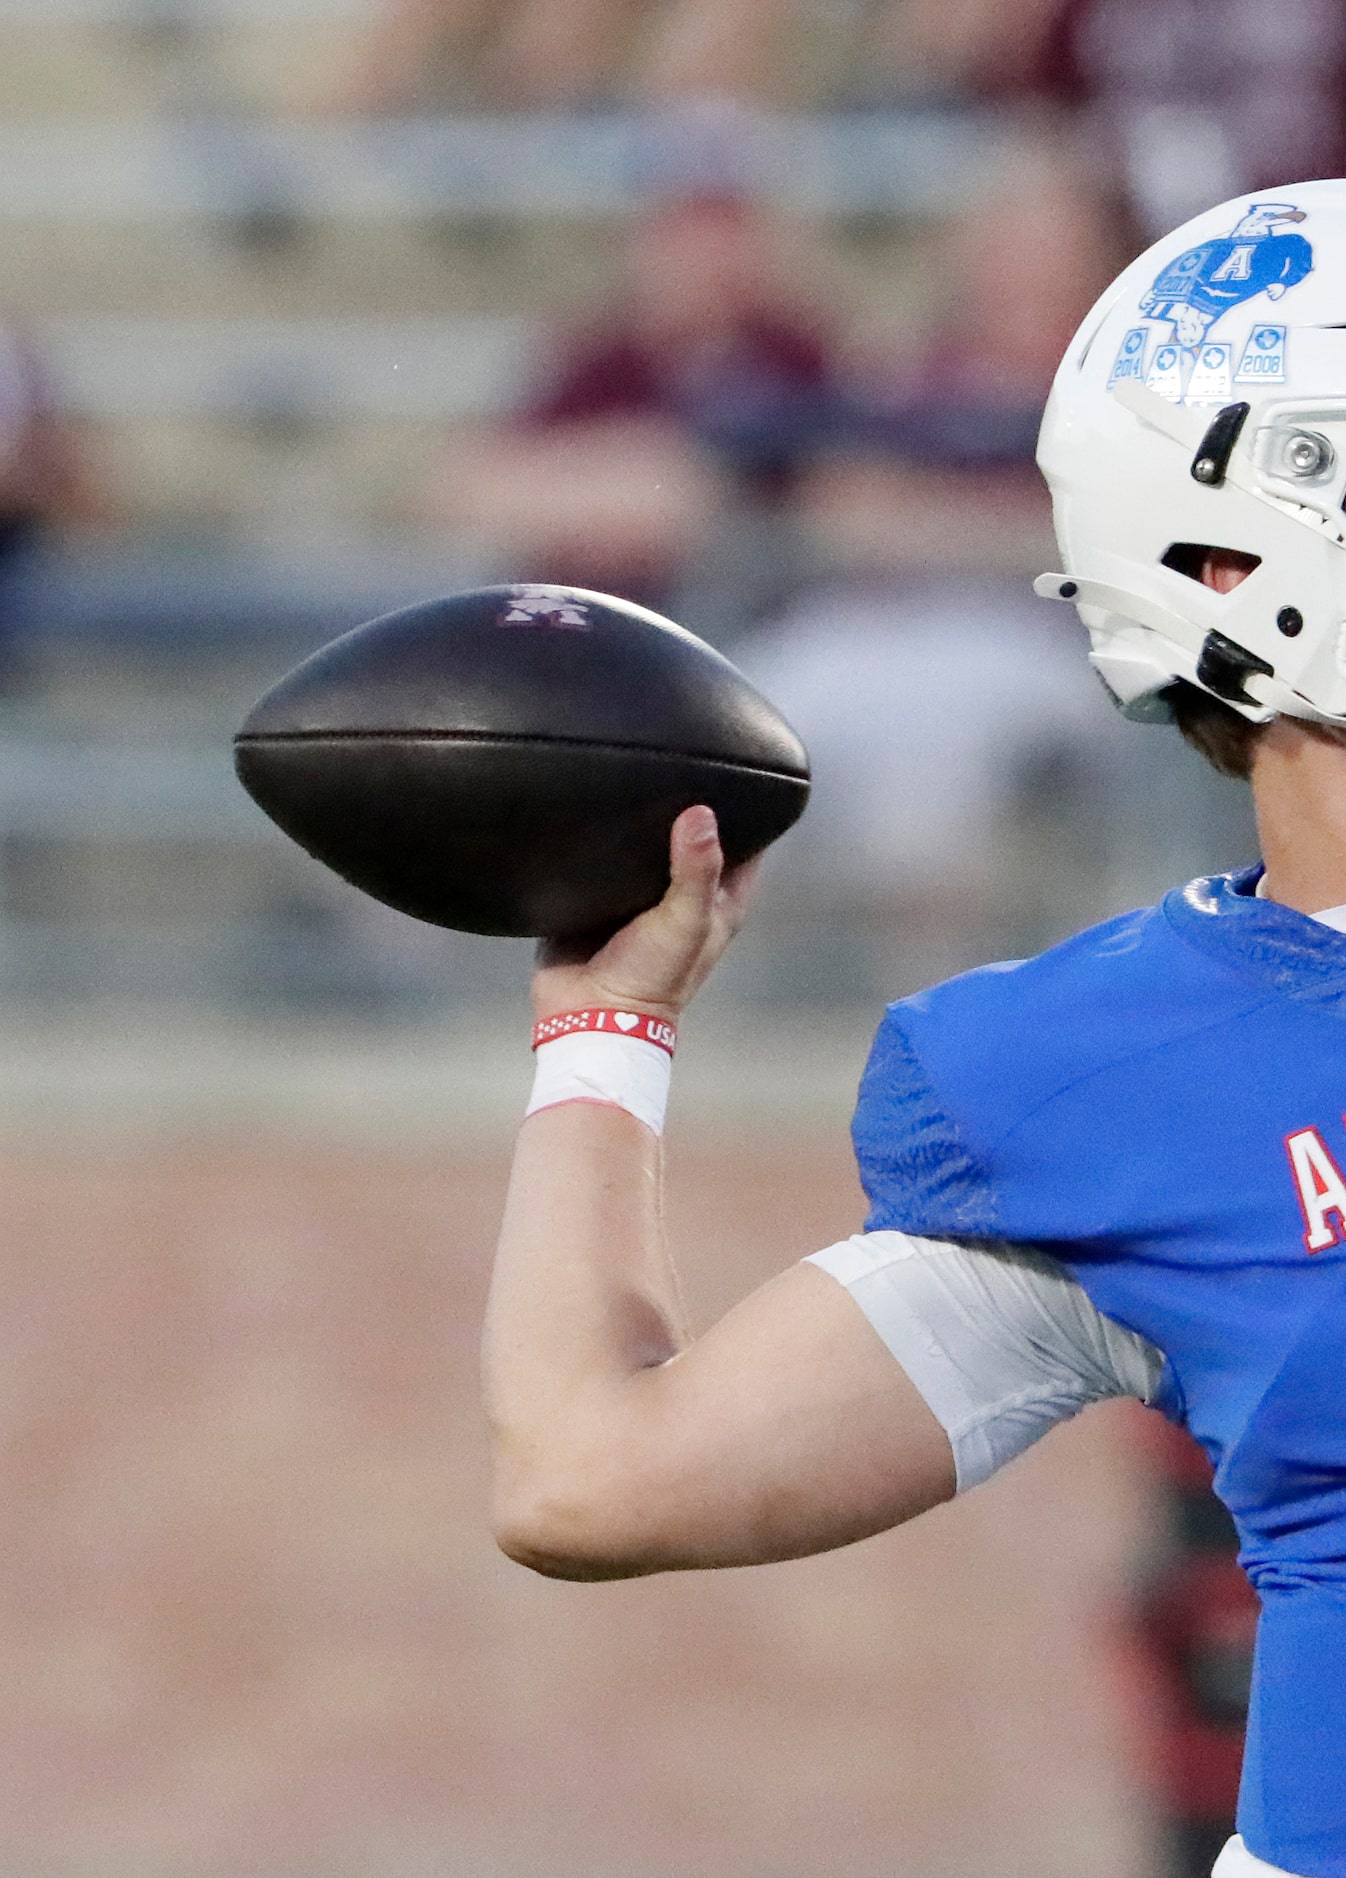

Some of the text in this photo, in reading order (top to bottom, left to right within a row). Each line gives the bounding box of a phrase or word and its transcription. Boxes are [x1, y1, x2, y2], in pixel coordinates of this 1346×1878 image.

[1209, 245, 1257, 282] A
[1114, 357, 1140, 378] 2014
[1243, 354, 1280, 374] 2008
[596, 1012, 605, 1028] I
